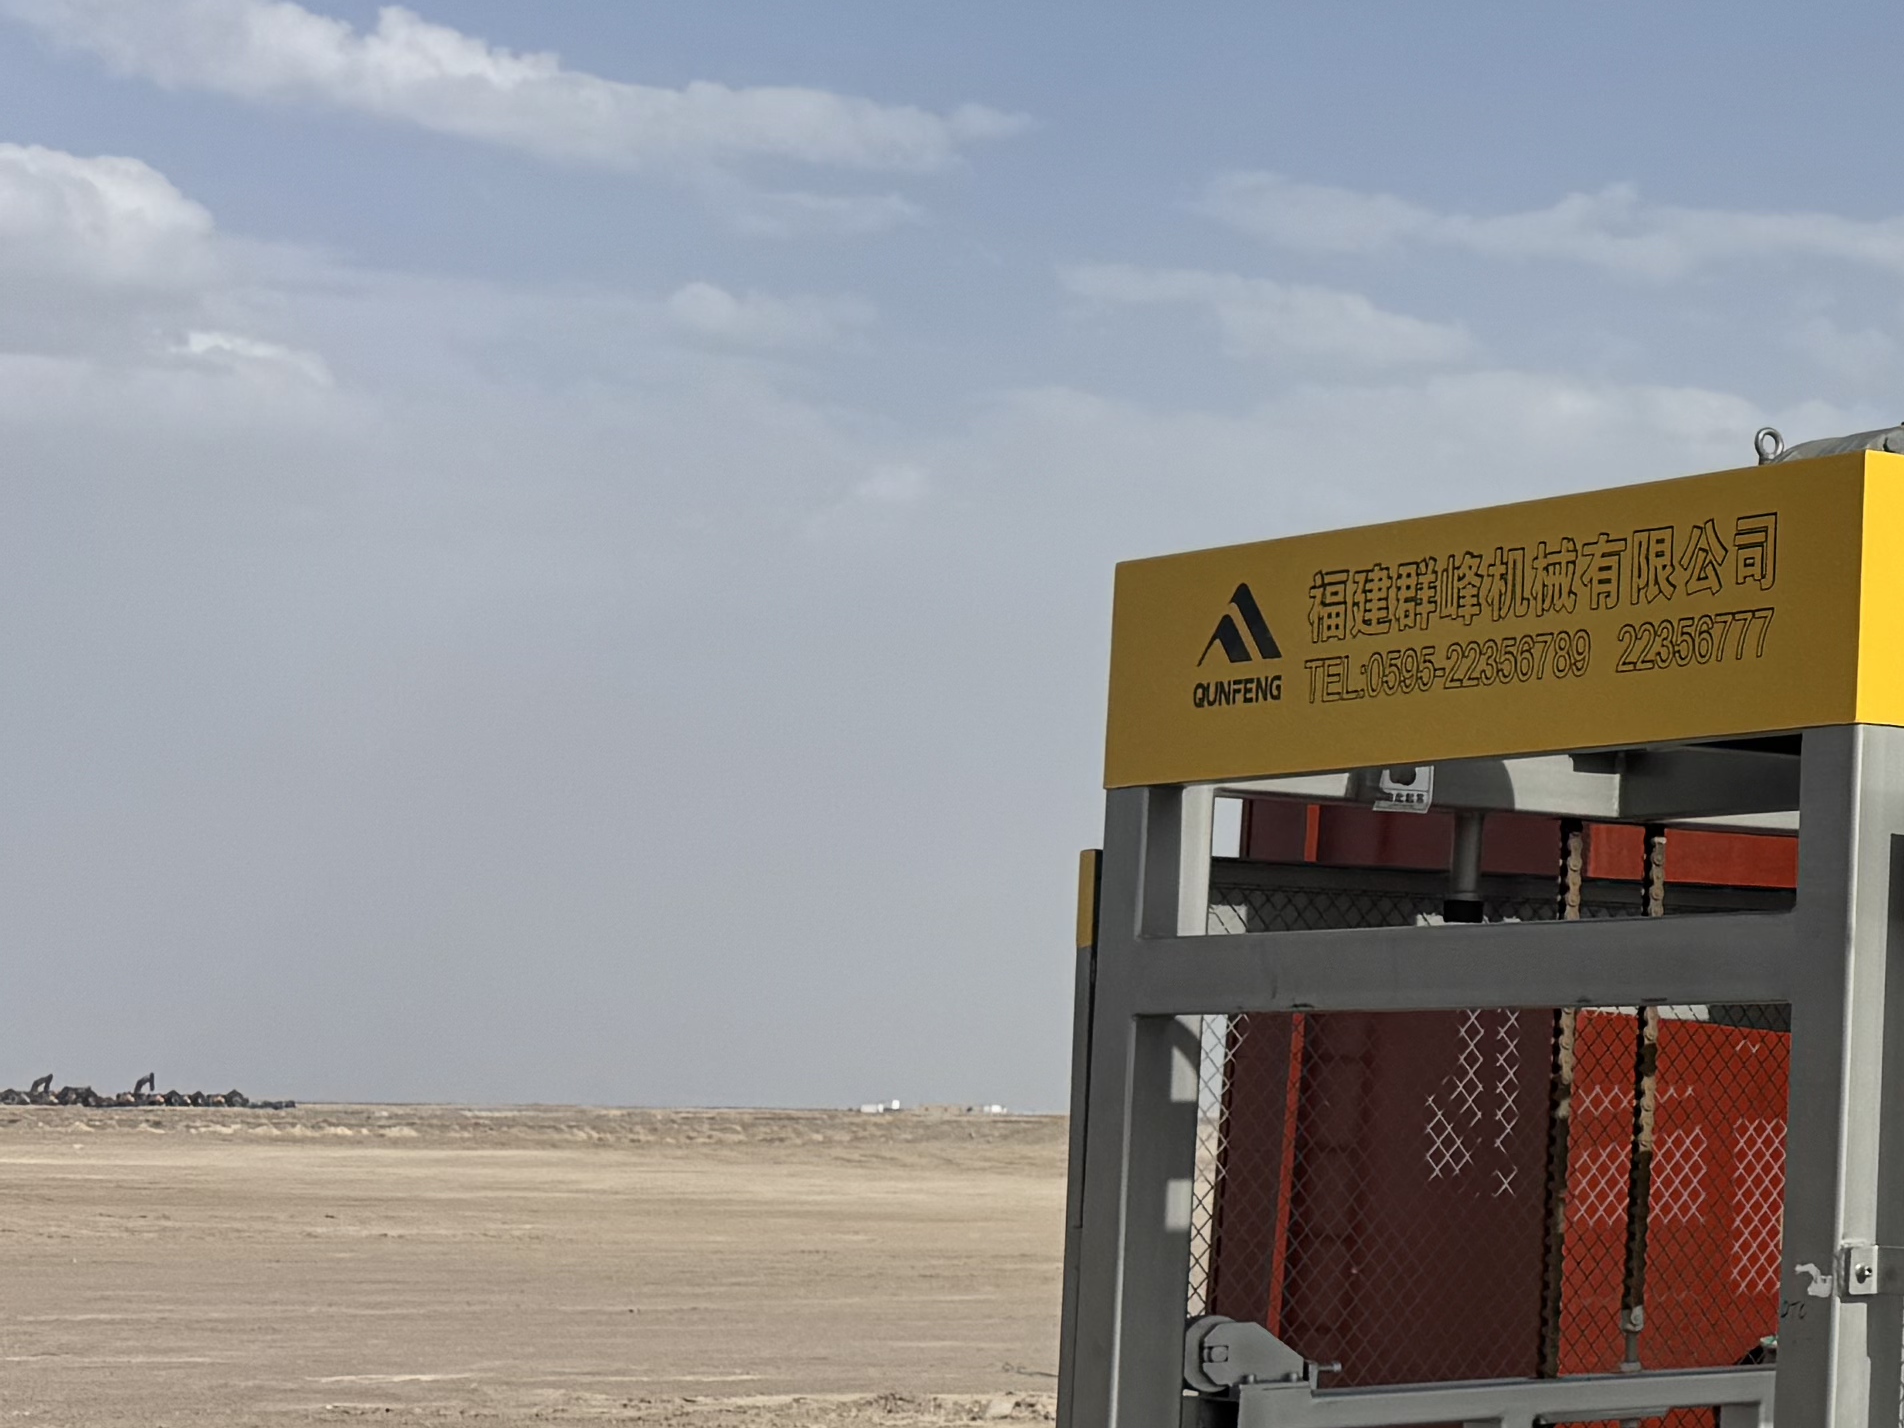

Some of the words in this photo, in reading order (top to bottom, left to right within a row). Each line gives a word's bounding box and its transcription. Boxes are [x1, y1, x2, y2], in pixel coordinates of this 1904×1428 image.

[1307, 511, 1778, 644] 福建群峰机械有限公司
[1192, 675, 1282, 709] QUNFENG
[1303, 628, 1592, 706] TEL:0595-22356789
[1615, 606, 1776, 674] 22356777
